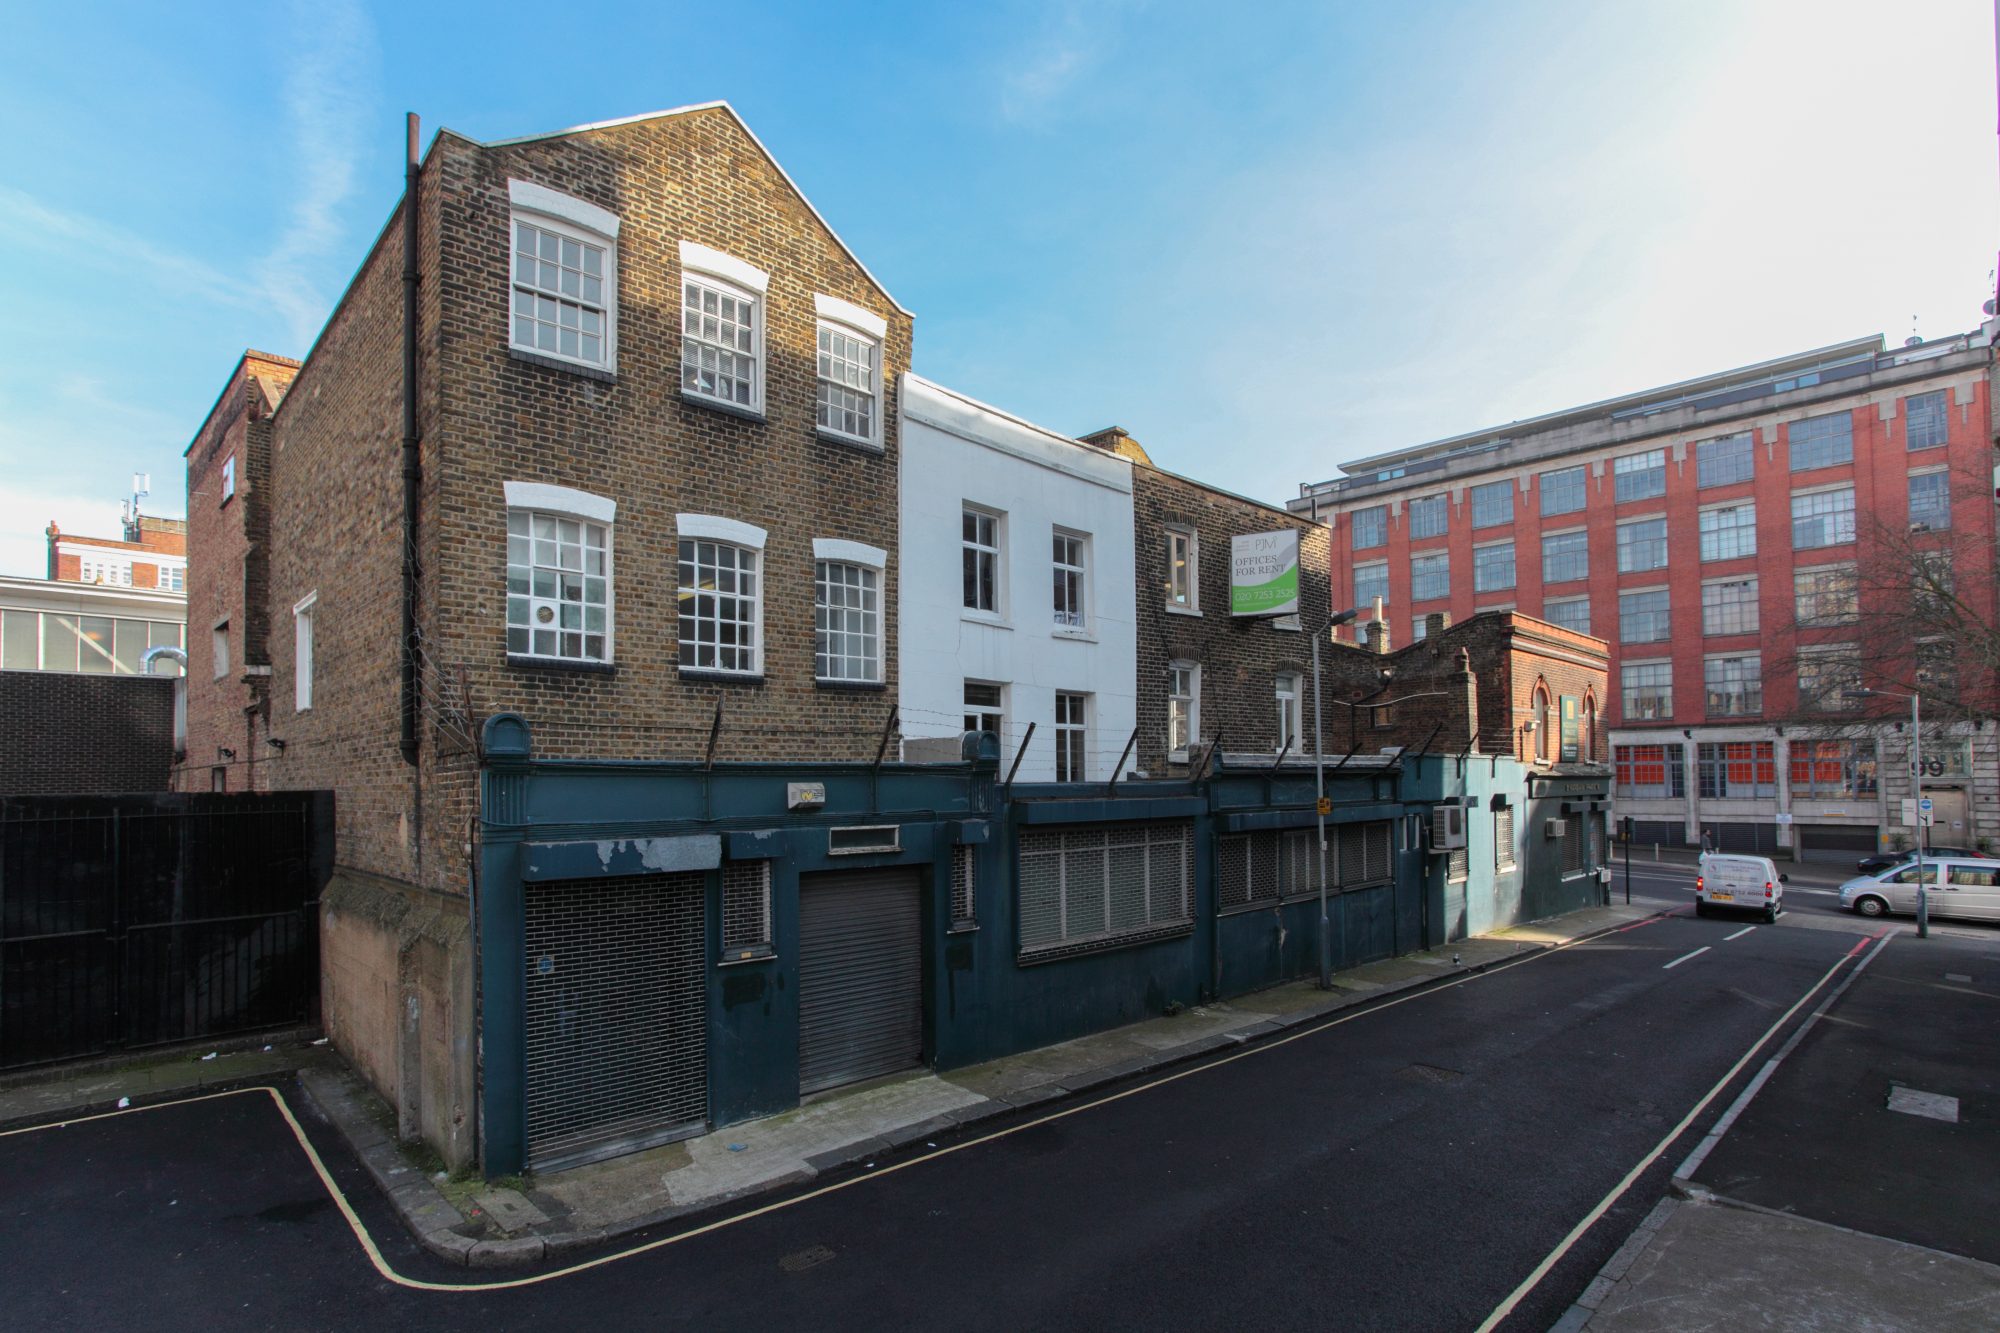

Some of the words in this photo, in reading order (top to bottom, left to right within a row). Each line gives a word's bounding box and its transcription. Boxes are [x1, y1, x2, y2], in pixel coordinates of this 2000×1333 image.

[1235, 555, 1276, 566] OFFICES
[1236, 568, 1255, 576] FOR
[1235, 592, 1251, 601] 020
[1911, 761, 1944, 776] 99
